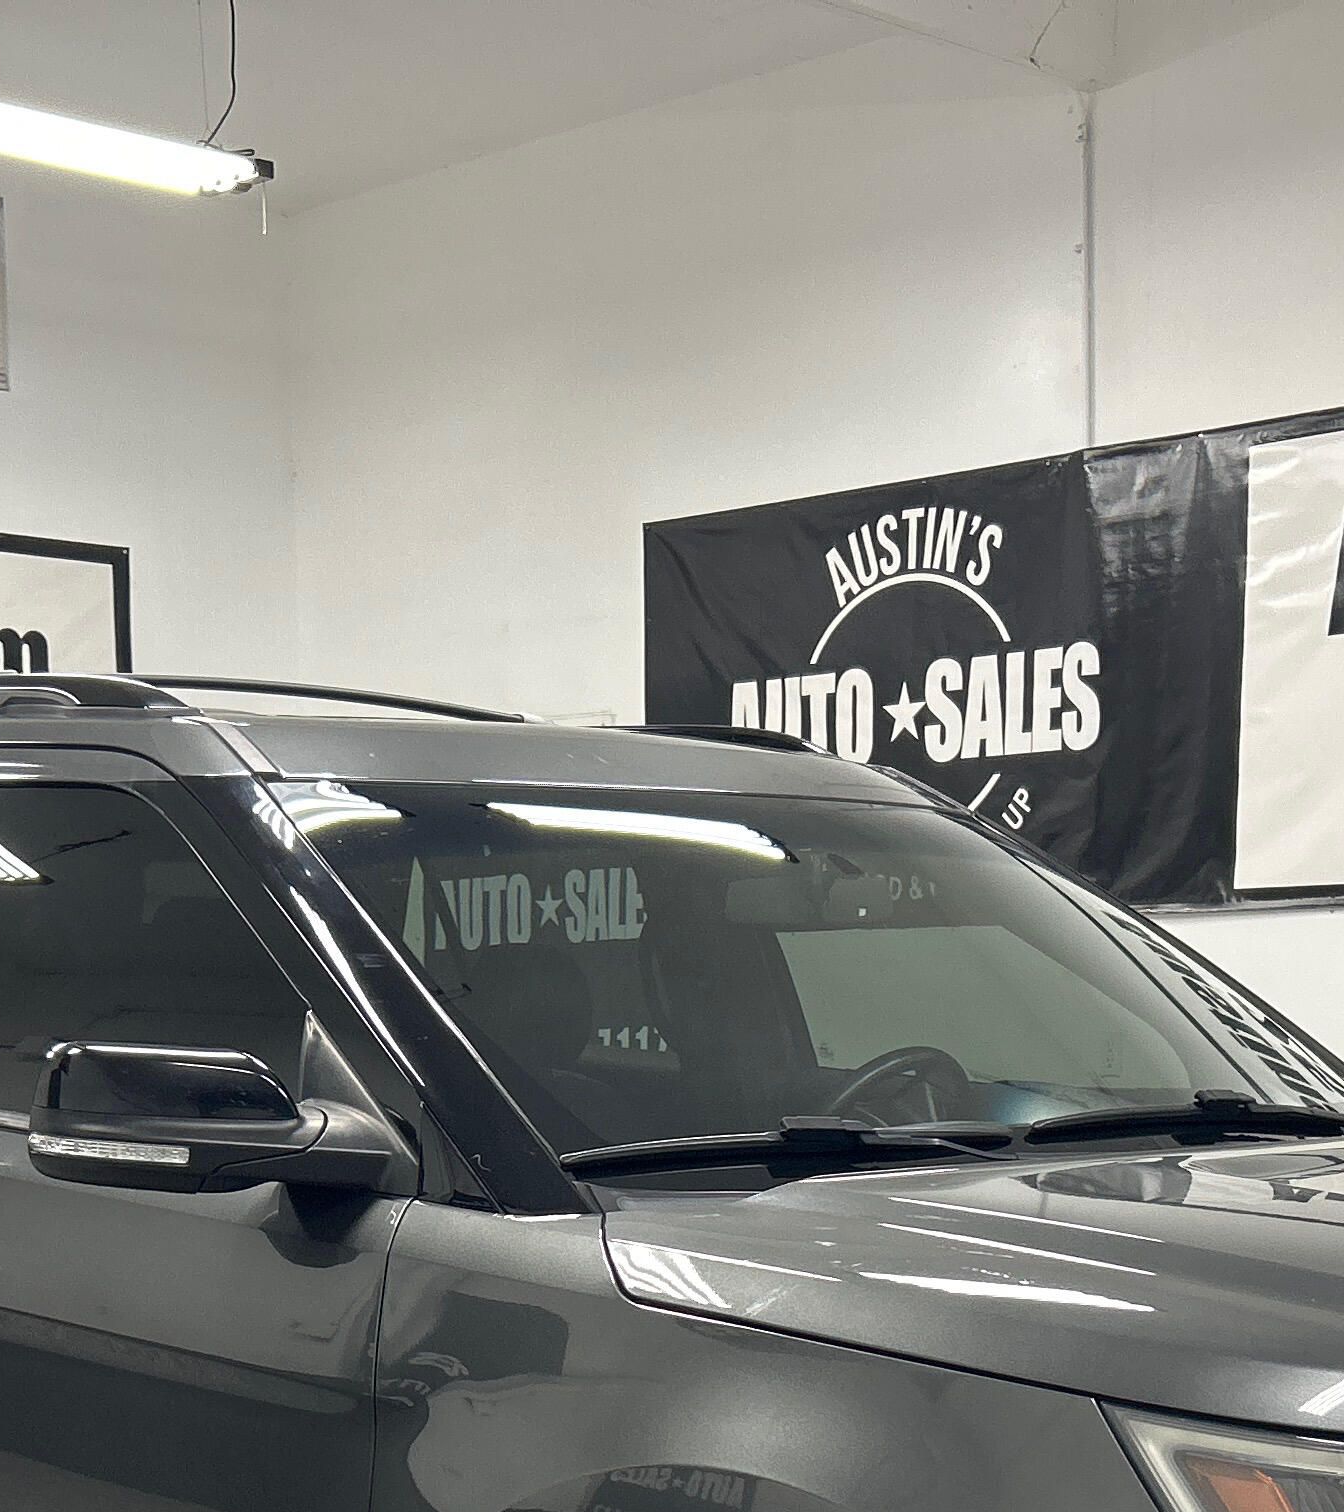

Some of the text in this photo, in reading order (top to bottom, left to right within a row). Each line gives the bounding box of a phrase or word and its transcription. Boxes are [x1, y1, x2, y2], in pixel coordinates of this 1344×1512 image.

[825, 506, 1003, 608] AUSTIN'S
[924, 641, 1101, 763] SALES
[1001, 787, 1033, 830] UP
